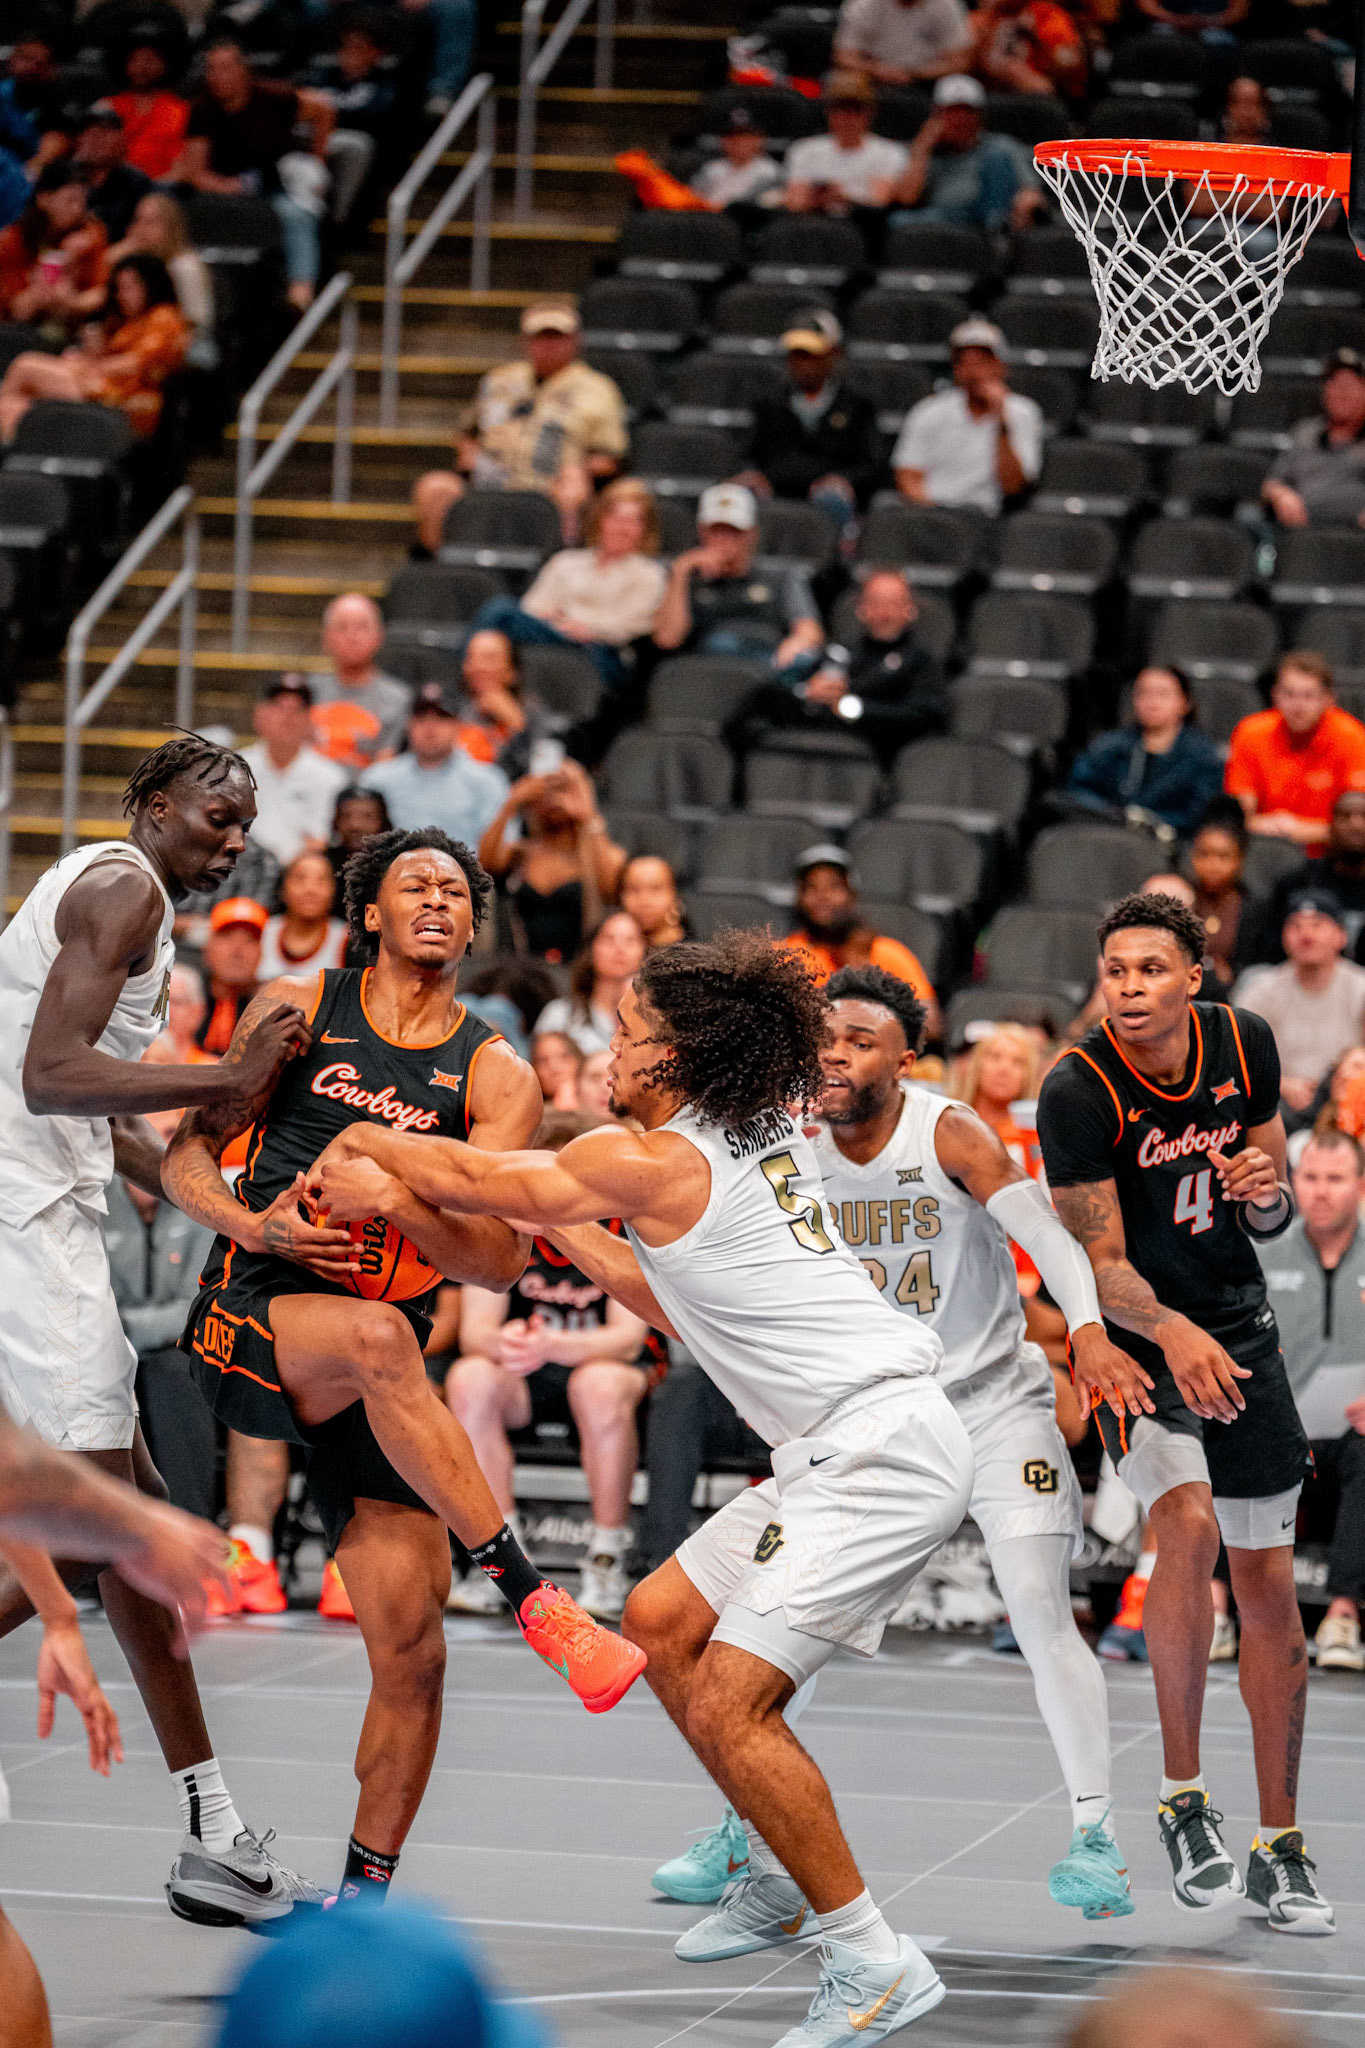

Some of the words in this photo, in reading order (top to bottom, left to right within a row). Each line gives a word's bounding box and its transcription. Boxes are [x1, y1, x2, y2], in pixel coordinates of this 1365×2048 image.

[311, 1062, 440, 1131] Cowboys
[724, 1106, 794, 1160] SANDERS
[1137, 1120, 1243, 1168] Cowboys
[760, 1150, 837, 1255] 5
[1173, 1168, 1214, 1235] 4
